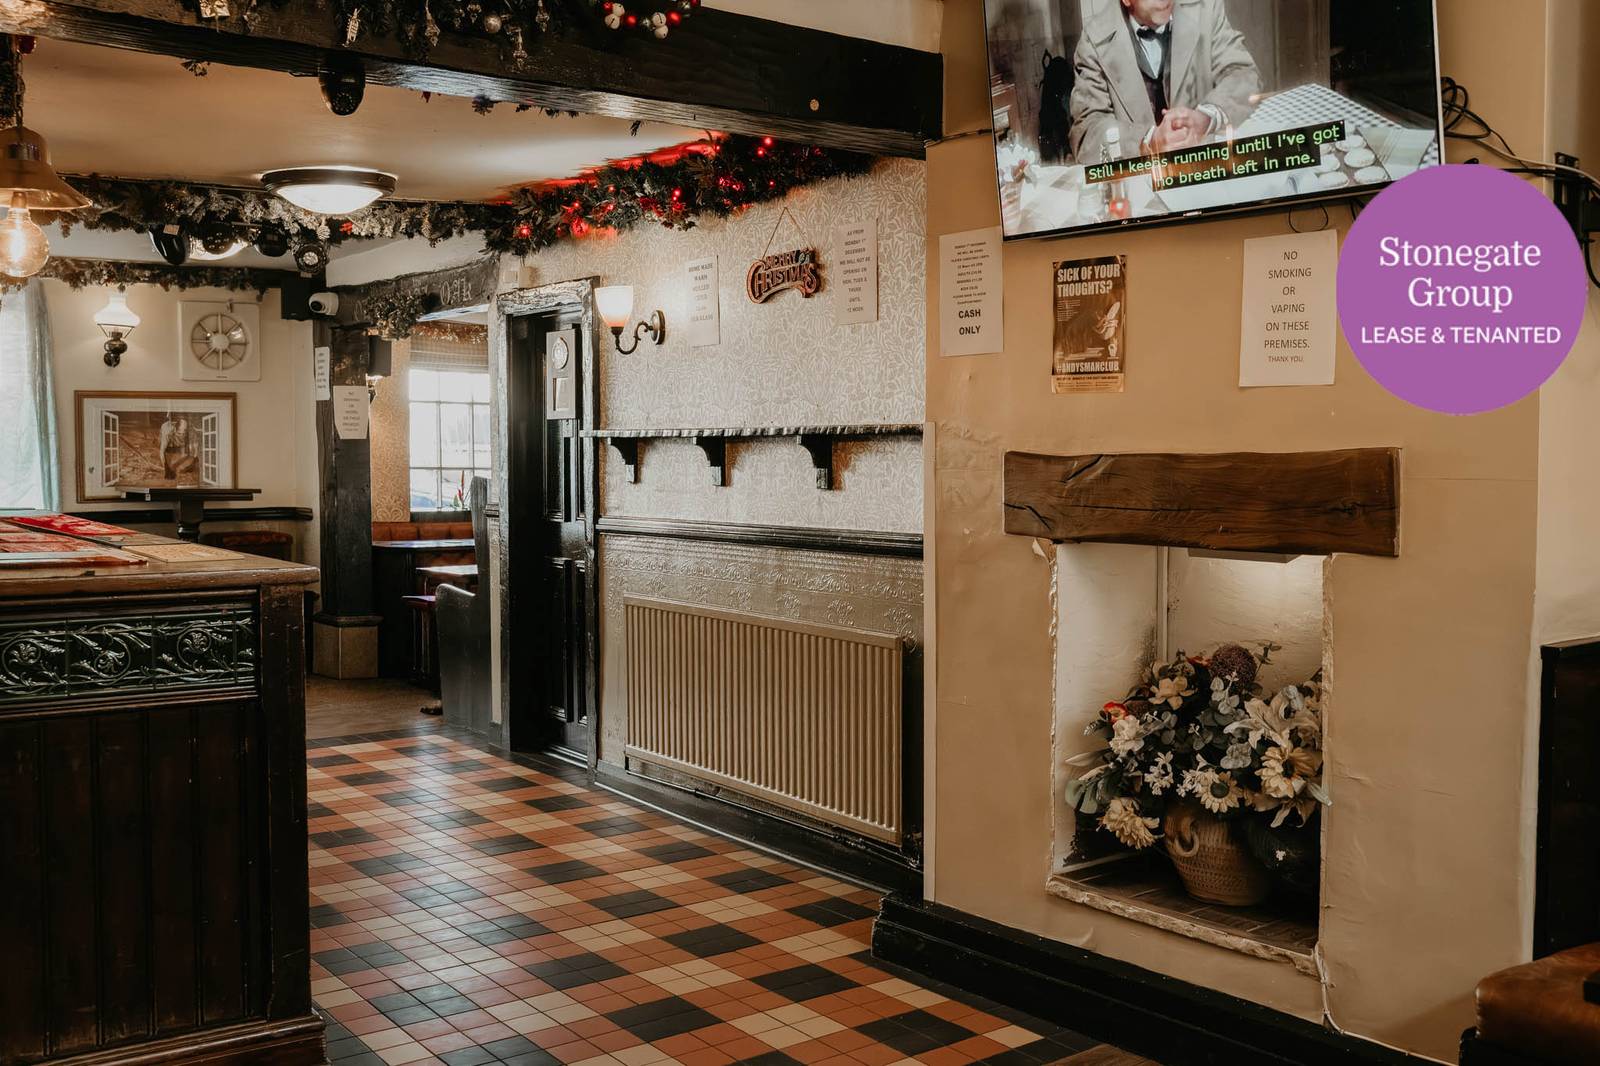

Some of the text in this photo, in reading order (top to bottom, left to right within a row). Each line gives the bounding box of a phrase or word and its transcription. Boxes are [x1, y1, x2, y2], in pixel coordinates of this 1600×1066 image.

[1088, 164, 1114, 180] Still
[1174, 147, 1229, 165] running
[1236, 136, 1272, 154] until
[1278, 134, 1305, 147] I've
[1313, 125, 1340, 145] got
[1156, 154, 1315, 187] no breath left in me.
[1283, 251, 1298, 260] NO
[1057, 264, 1120, 282] SICK OF YOUR
[1268, 268, 1312, 279] SMOKING
[747, 260, 817, 304] CHRISTMAS
[1057, 280, 1113, 297] THOUGHTS?
[1282, 286, 1296, 295] OR
[958, 309, 981, 318] CASH
[1271, 304, 1305, 314] VAPING
[959, 325, 981, 335] ONLY
[1266, 321, 1309, 331] ON THESE
[1264, 339, 1310, 348] PREMISES.
